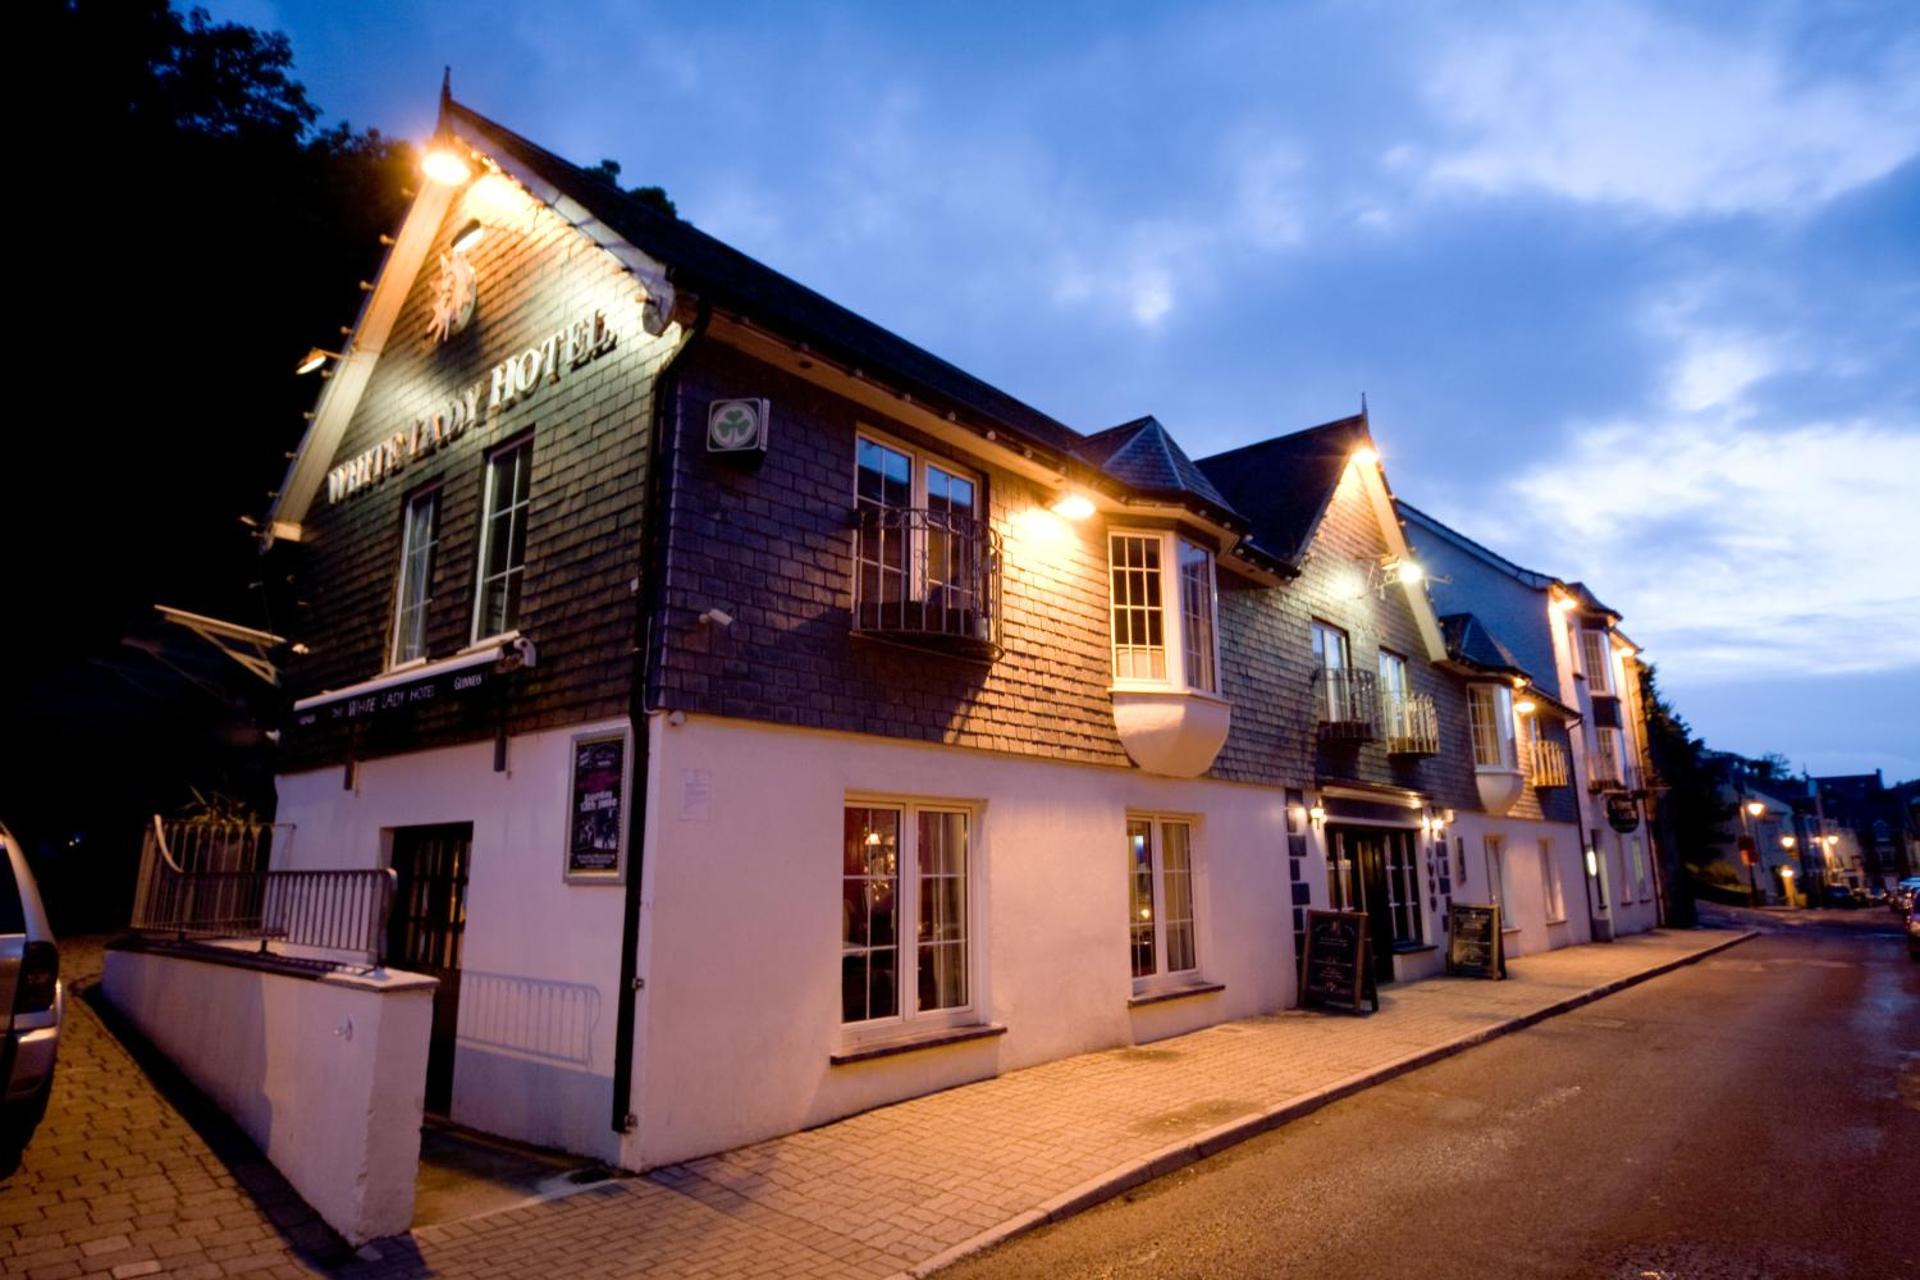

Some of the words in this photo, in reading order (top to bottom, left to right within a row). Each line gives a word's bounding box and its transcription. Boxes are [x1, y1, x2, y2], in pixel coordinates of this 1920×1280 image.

[409, 382, 482, 457] LADY
[489, 308, 617, 413] HOTEL
[382, 692, 405, 709] LADY
[410, 684, 435, 702] HOTEL
